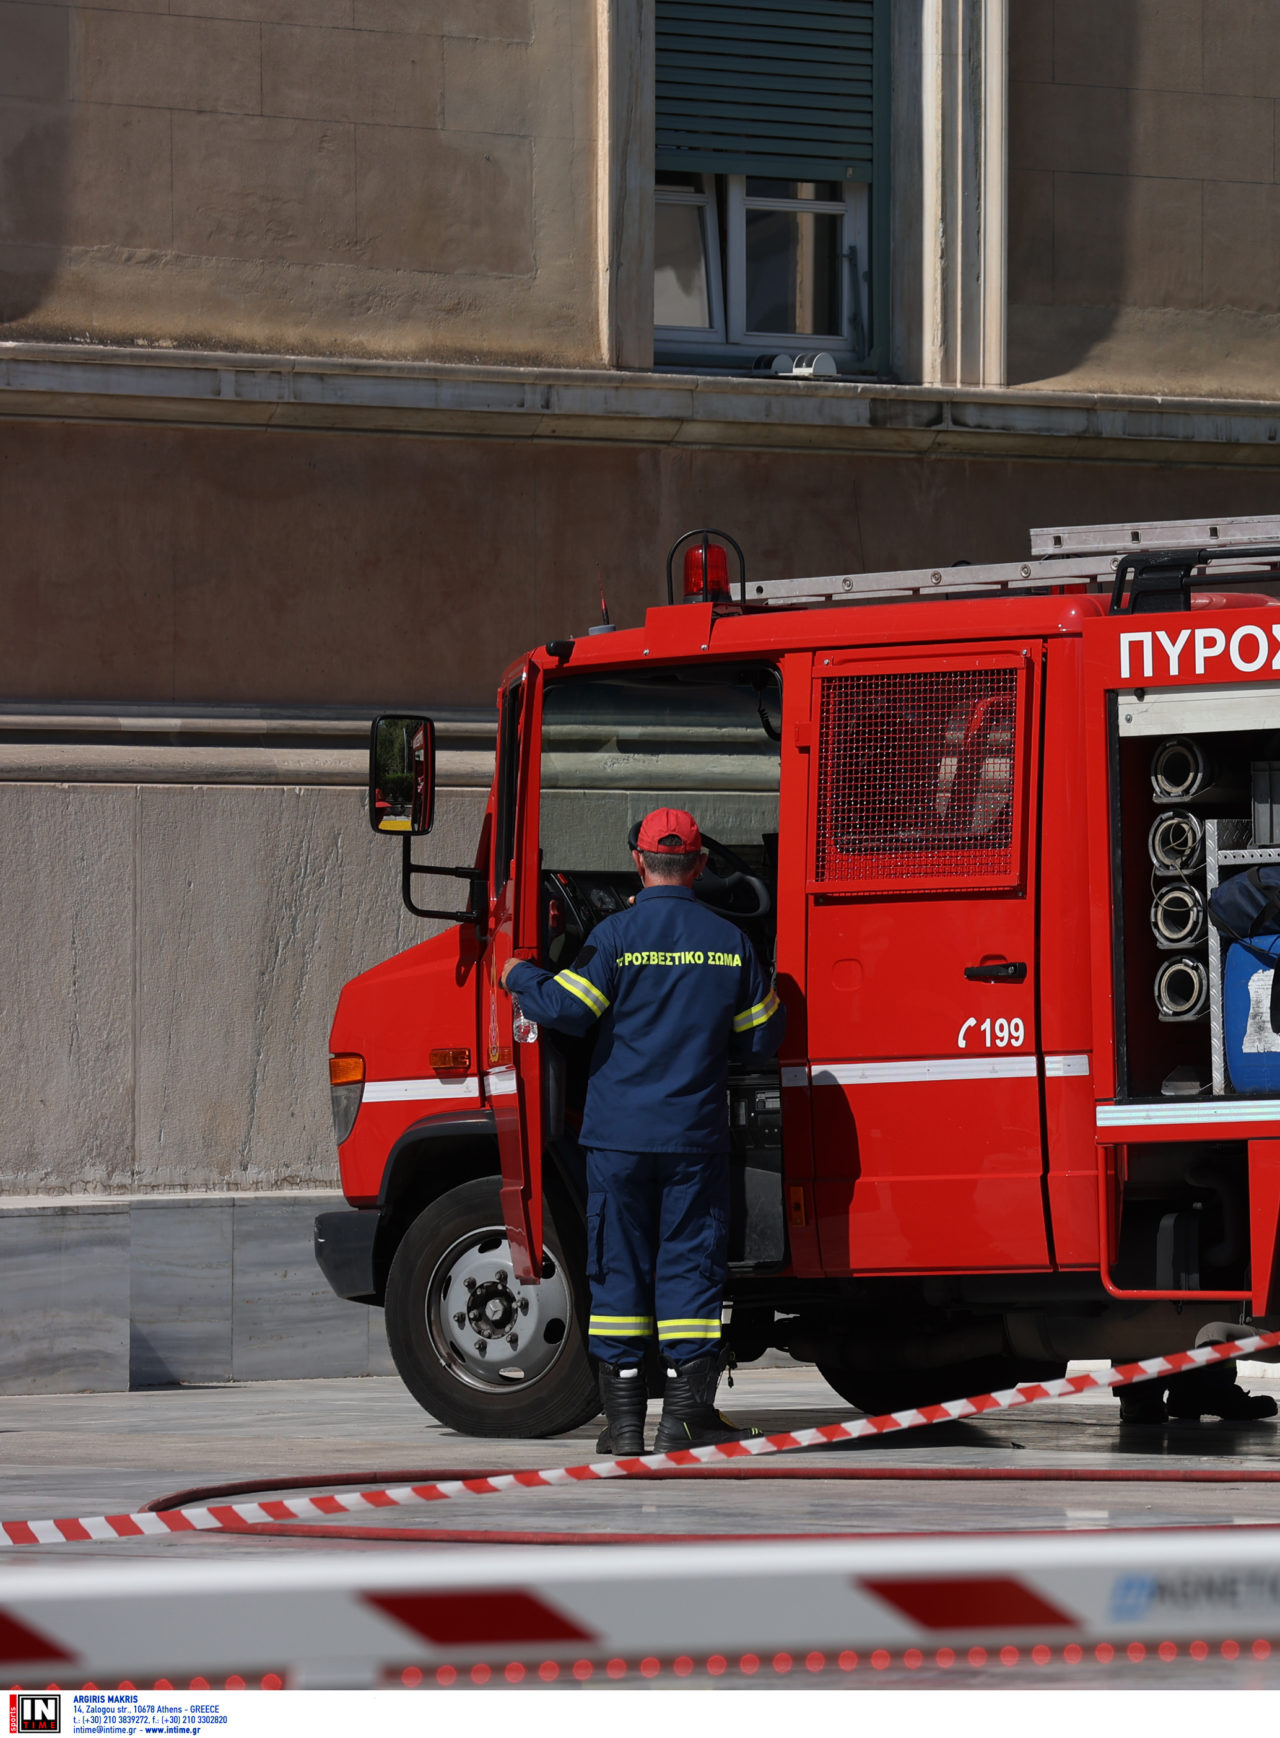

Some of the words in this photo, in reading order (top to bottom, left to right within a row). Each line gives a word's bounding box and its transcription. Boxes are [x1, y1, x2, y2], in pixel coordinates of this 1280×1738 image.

[616, 951, 704, 967] ΡΟΣΒΕΣΤΙΚΟ
[707, 951, 742, 967] ΣΩΜΑ
[980, 1017, 1025, 1047] 199
